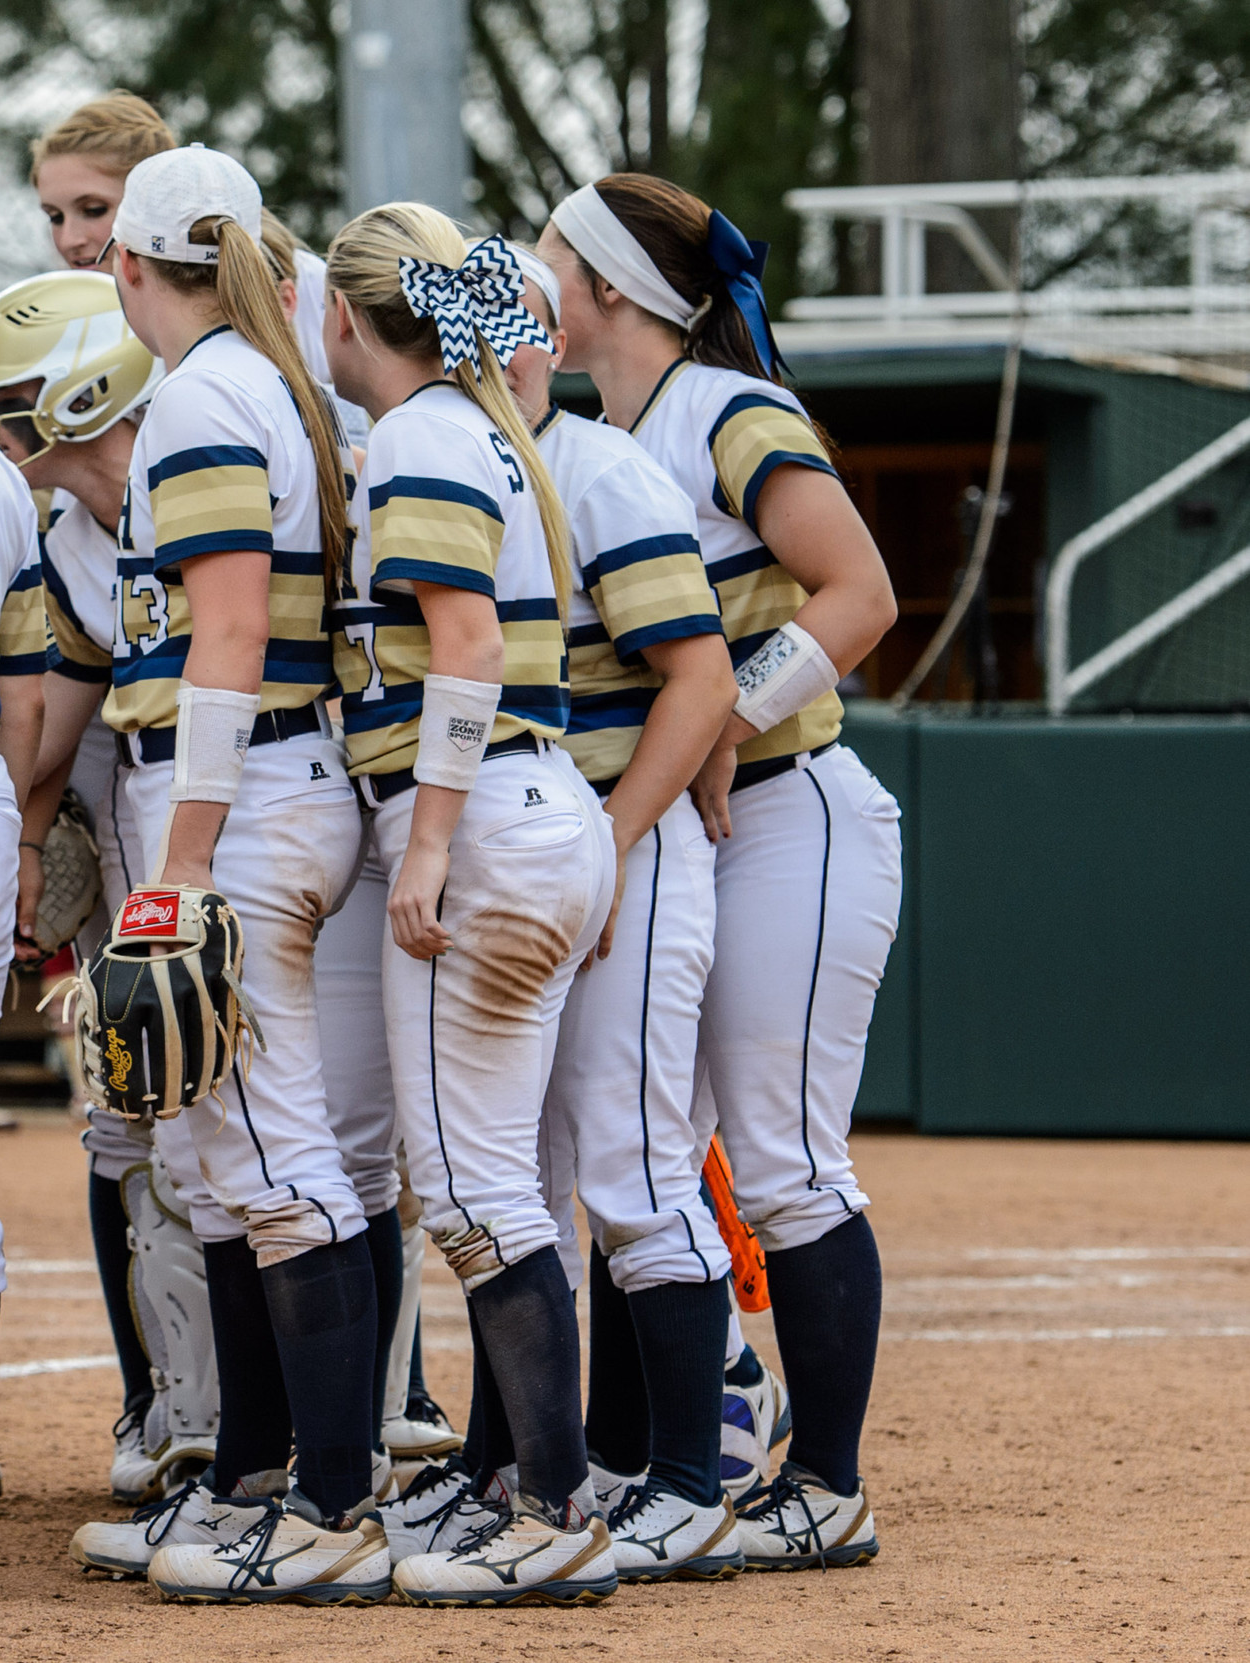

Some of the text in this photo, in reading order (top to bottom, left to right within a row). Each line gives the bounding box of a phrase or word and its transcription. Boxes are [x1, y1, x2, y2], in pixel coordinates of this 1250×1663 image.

[203, 250, 219, 261] JAC
[113, 574, 170, 658] 13
[344, 622, 386, 702] 7
[449, 732, 482, 743] SPORTS
[450, 724, 484, 737] ZONE
[310, 762, 326, 774] R
[525, 787, 542, 801] R
[125, 901, 173, 925] Rawlings
[105, 1026, 132, 1092] Rawlings
